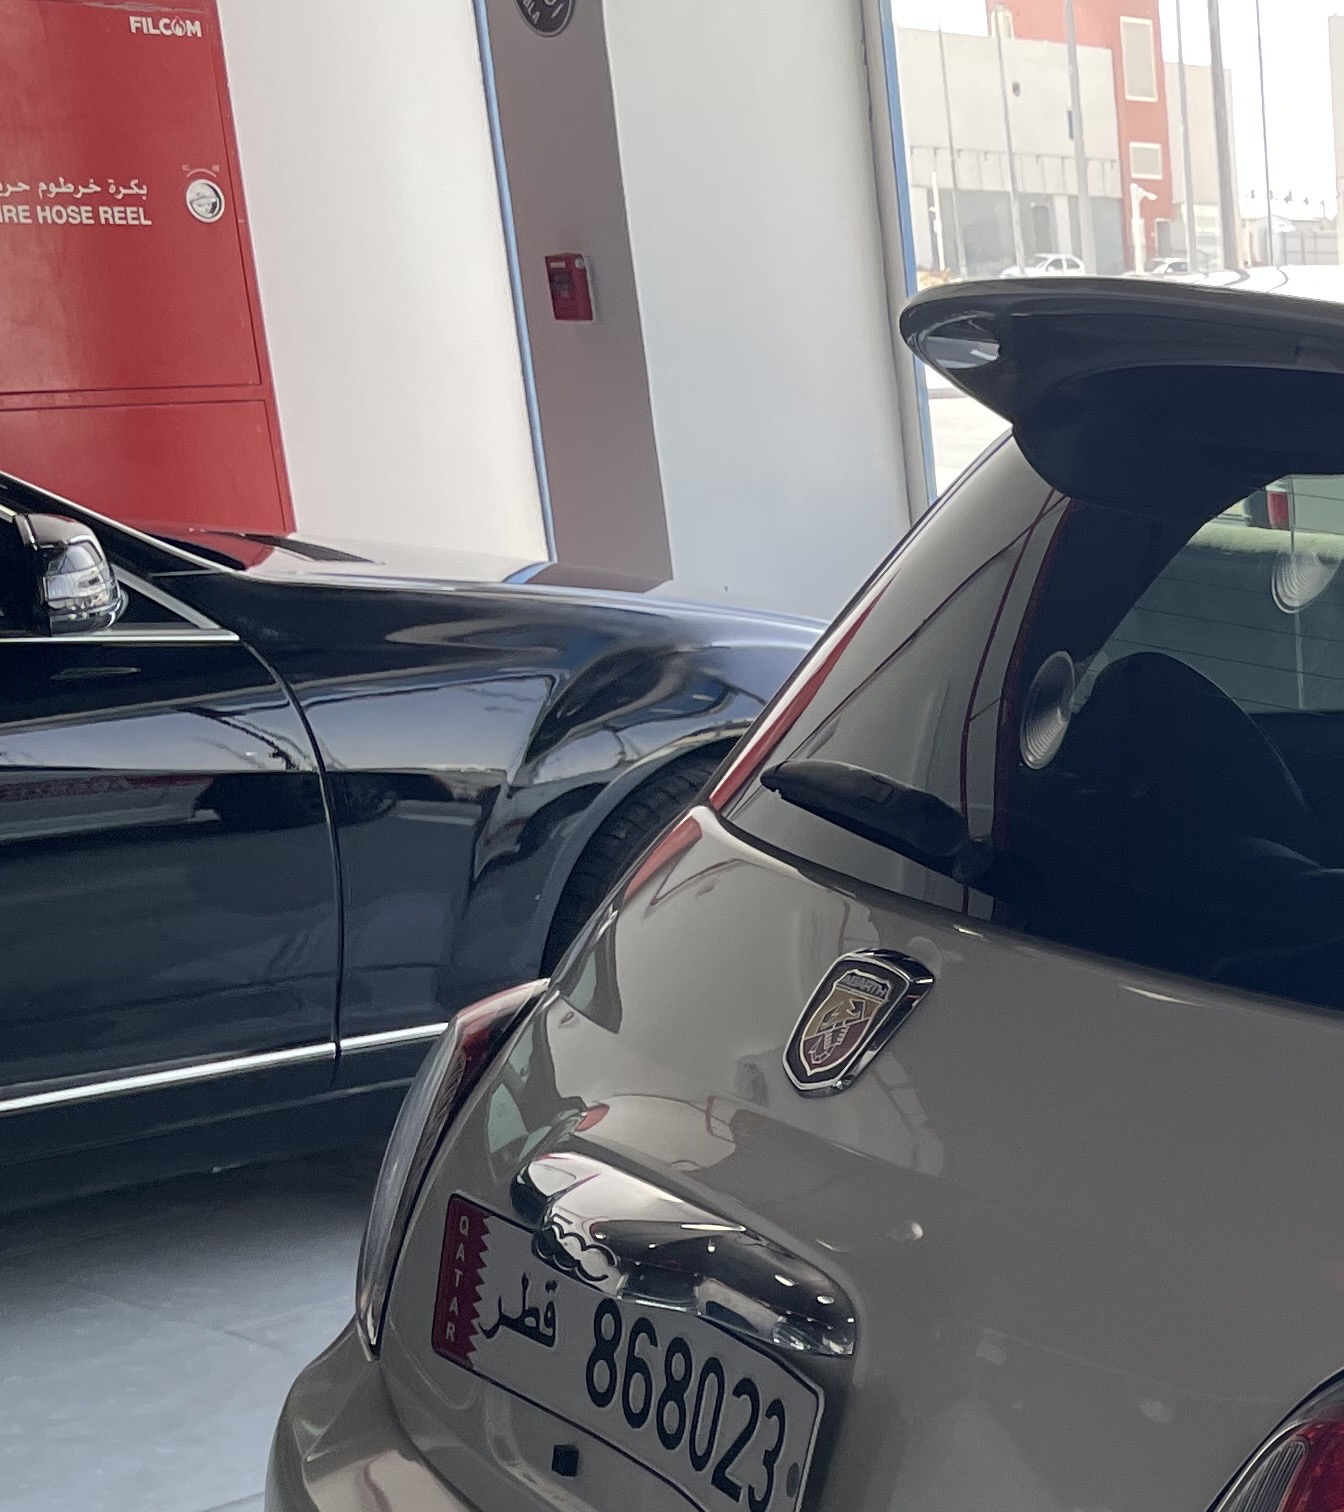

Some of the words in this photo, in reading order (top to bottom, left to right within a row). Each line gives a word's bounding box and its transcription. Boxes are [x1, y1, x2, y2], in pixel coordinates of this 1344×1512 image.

[129, 16, 203, 38] FILCOM
[38, 176, 102, 200] خرطوم
[107, 177, 148, 201] بكرة
[0, 204, 33, 225] IRE
[36, 205, 95, 226] HOSE
[99, 206, 152, 226] REEL
[445, 1214, 470, 1342] QATAR
[478, 1273, 557, 1349] قطر
